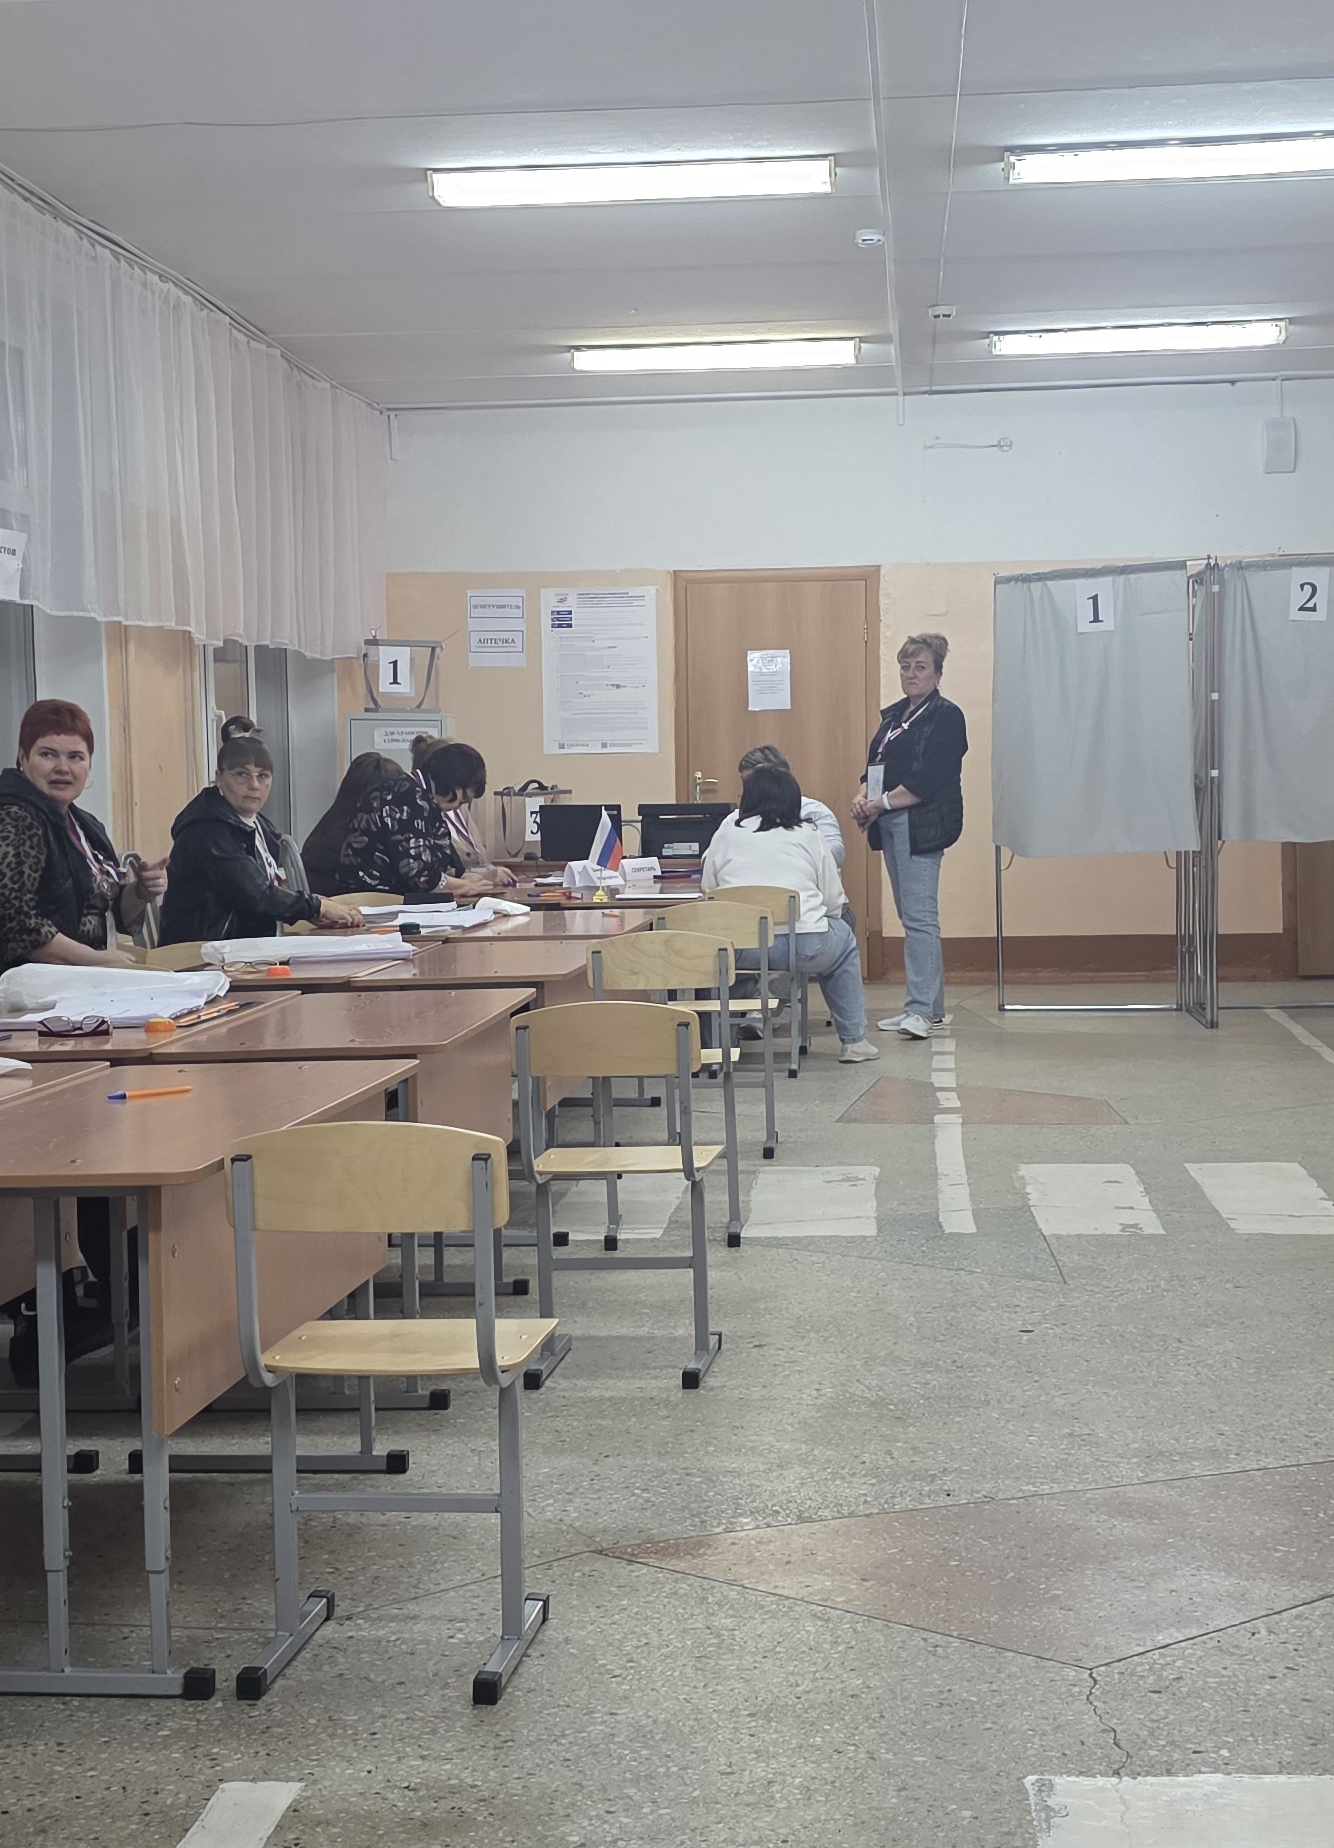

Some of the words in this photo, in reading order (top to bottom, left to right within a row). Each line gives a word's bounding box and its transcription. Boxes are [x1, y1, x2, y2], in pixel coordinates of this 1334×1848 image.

[1085, 593, 1105, 624] 1
[1297, 582, 1319, 613] 2
[477, 637, 516, 645] АПТЕЧКА
[387, 658, 402, 685] 1
[530, 810, 540, 835] 3
